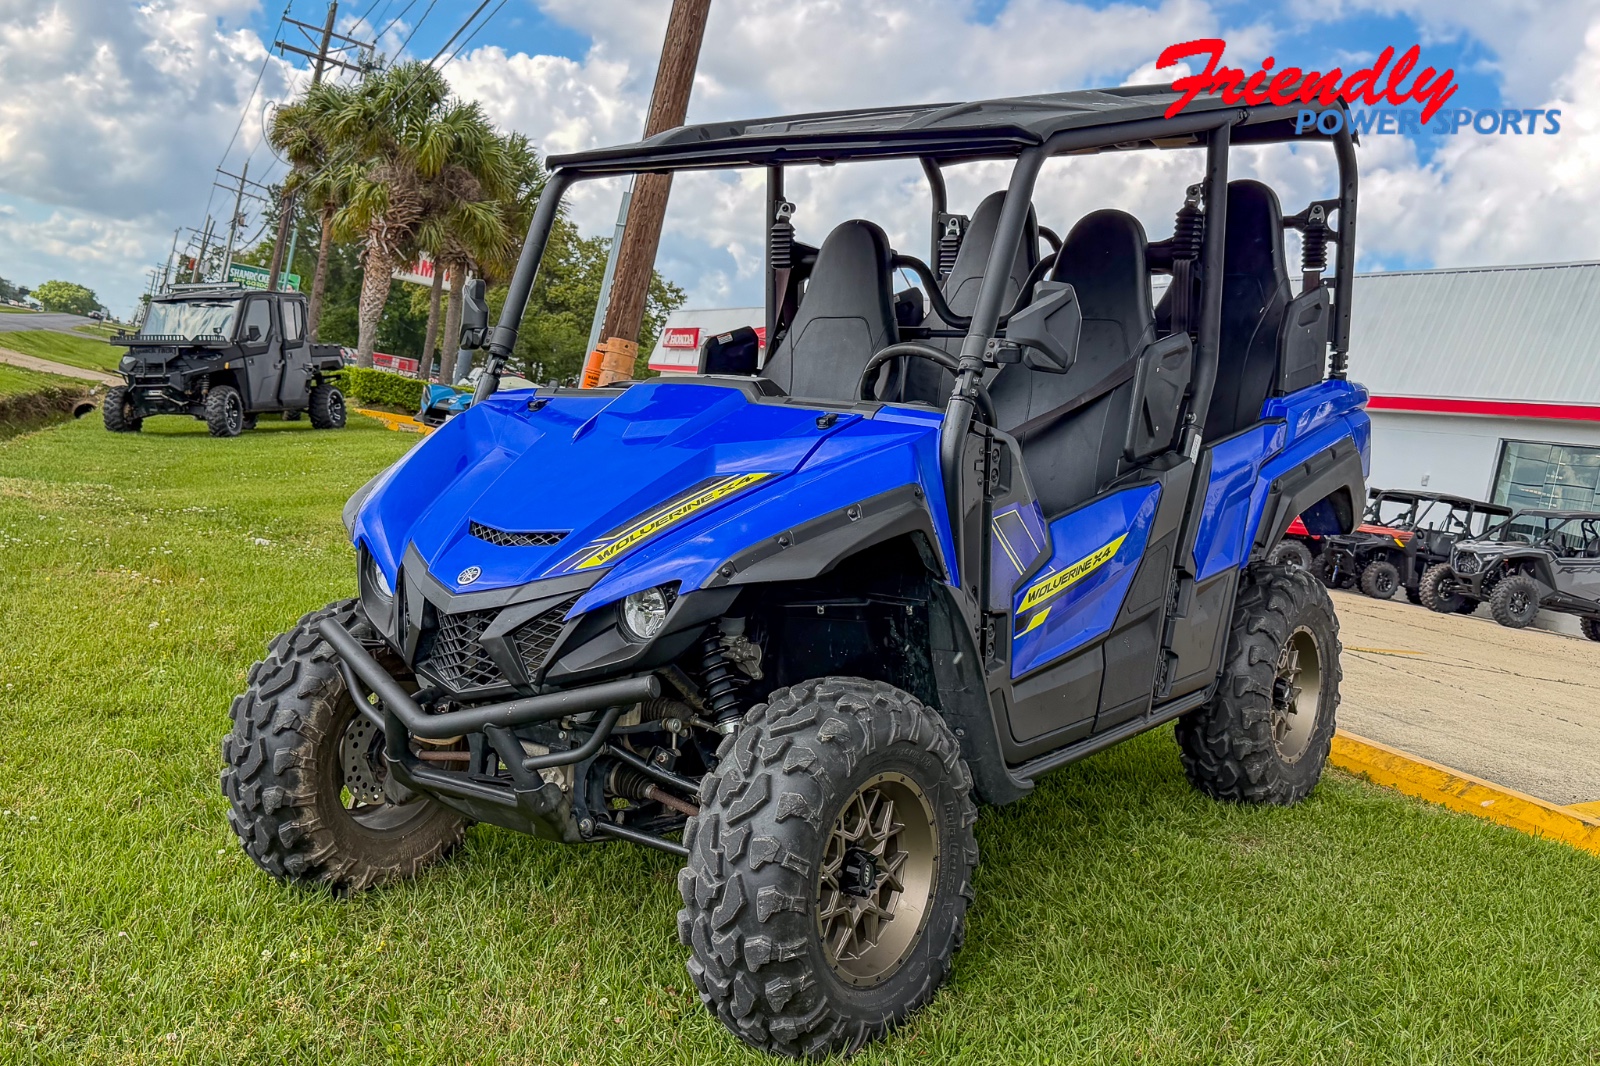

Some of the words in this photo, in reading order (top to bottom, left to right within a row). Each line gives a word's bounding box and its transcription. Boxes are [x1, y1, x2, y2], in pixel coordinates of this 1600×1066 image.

[669, 334, 695, 346] HONDA
[596, 491, 715, 562] WOLVERINE
[717, 475, 754, 497] X4
[1027, 557, 1093, 604] WOLVERINE
[1093, 546, 1112, 566] X4
